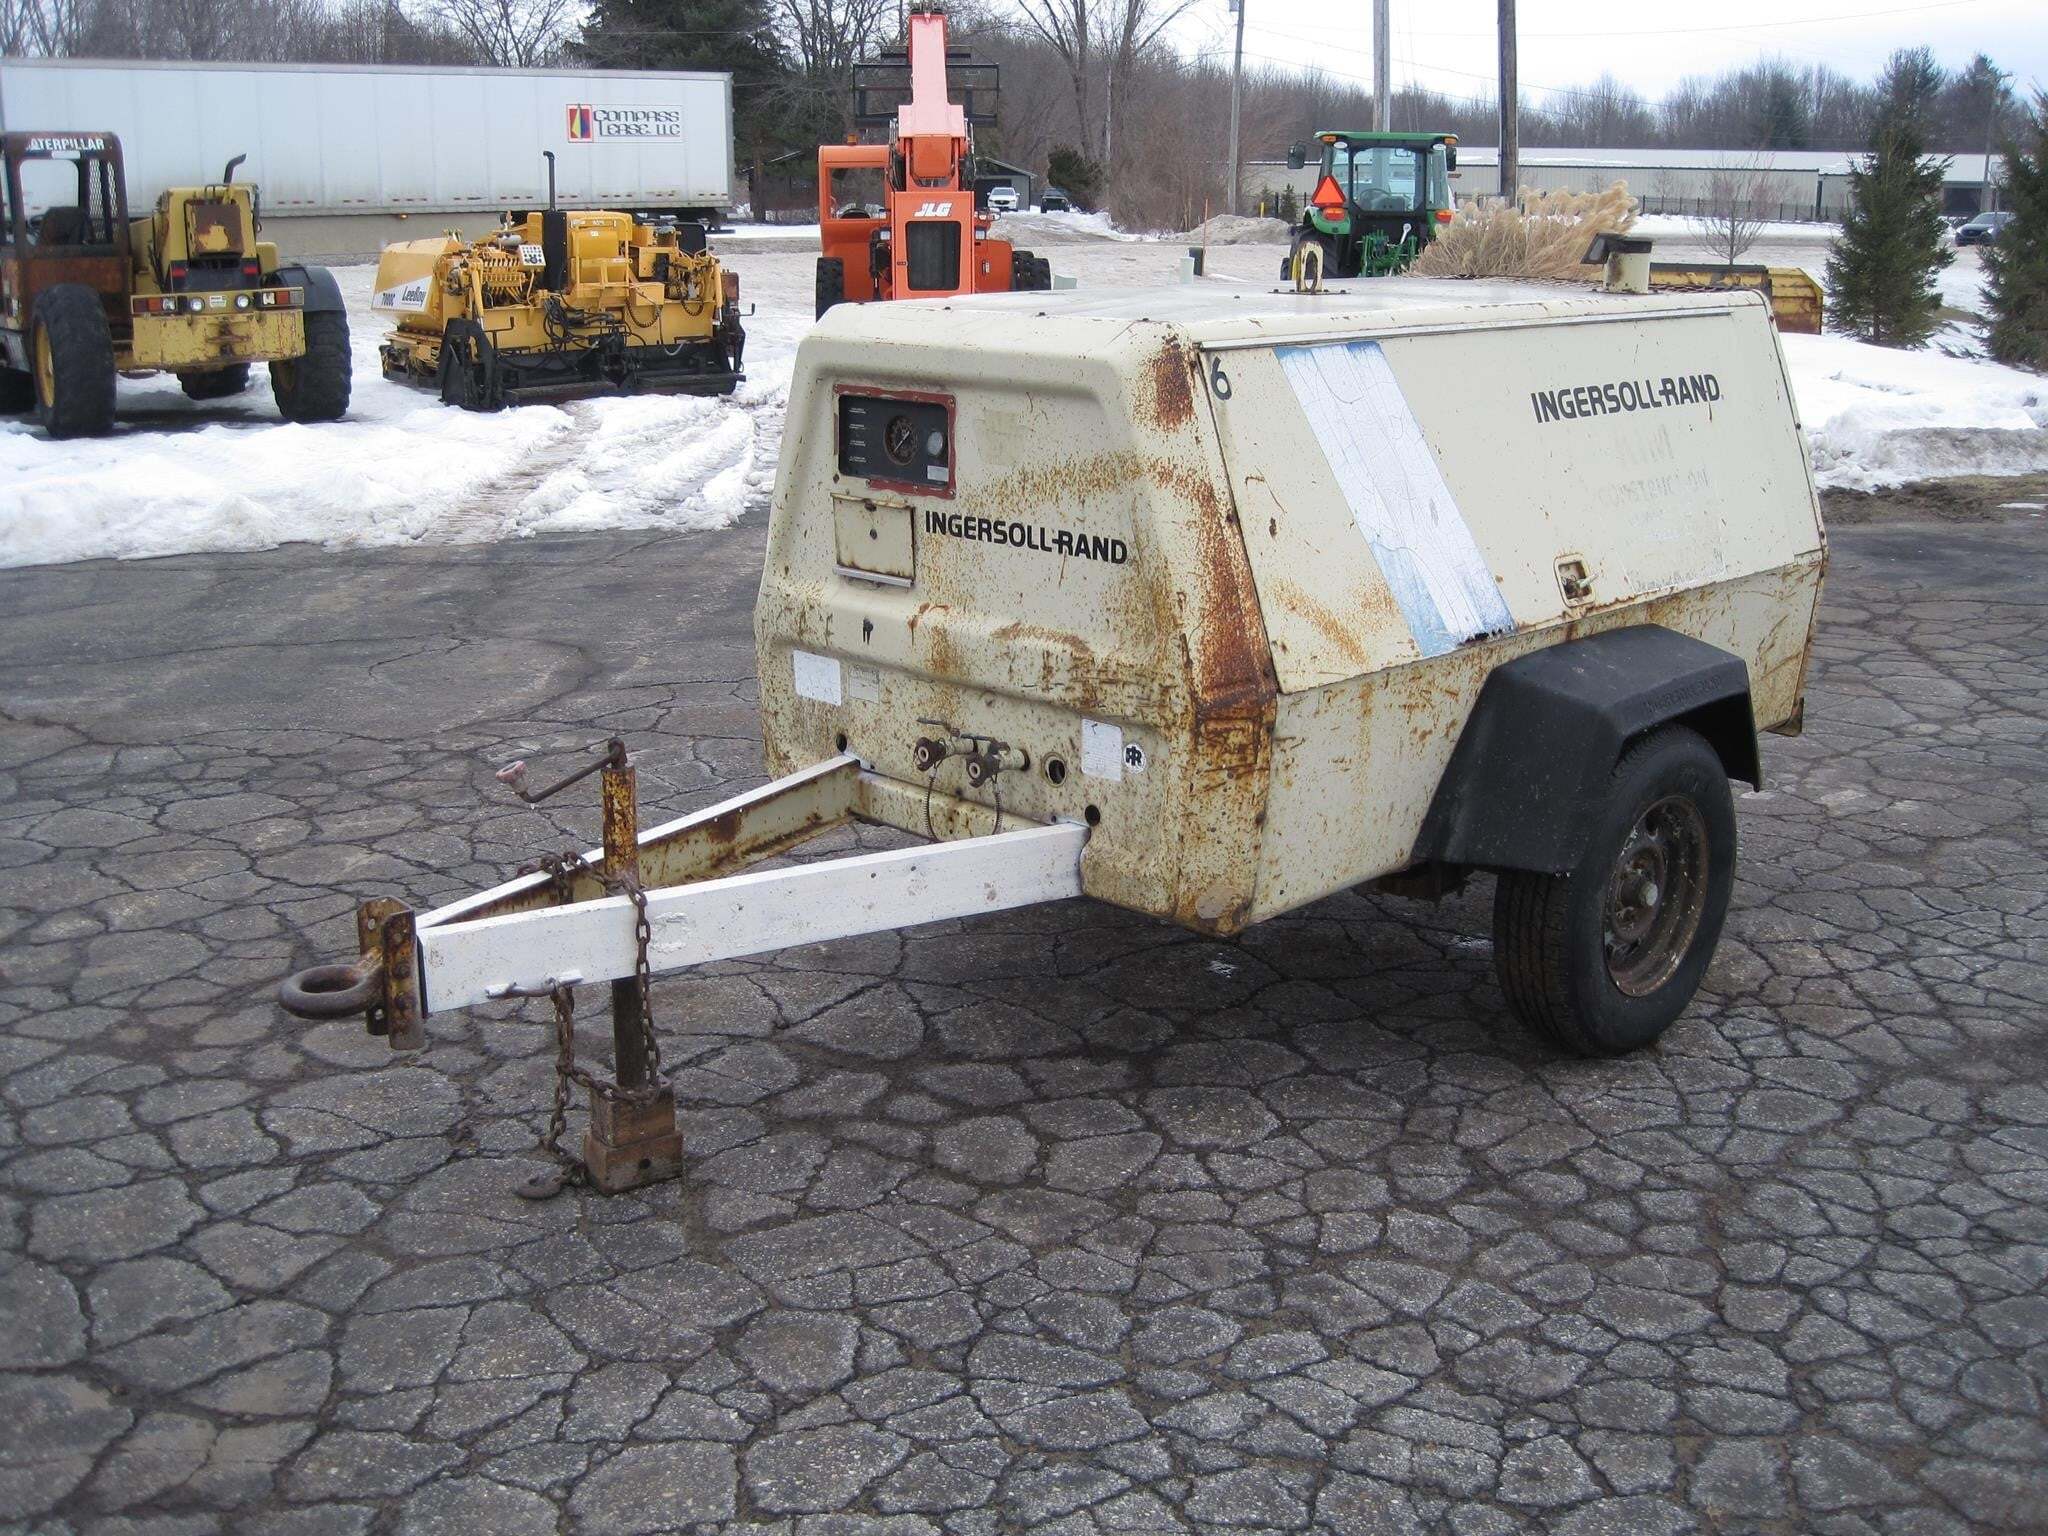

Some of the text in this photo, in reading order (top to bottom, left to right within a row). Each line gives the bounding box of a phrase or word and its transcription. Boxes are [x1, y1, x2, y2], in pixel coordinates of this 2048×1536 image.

[914, 202, 953, 217] JLG
[1210, 355, 1233, 401] 6
[1530, 373, 1720, 424] INGERSOLL-RAND
[924, 510, 1128, 565] INGERSOLL-RAND
